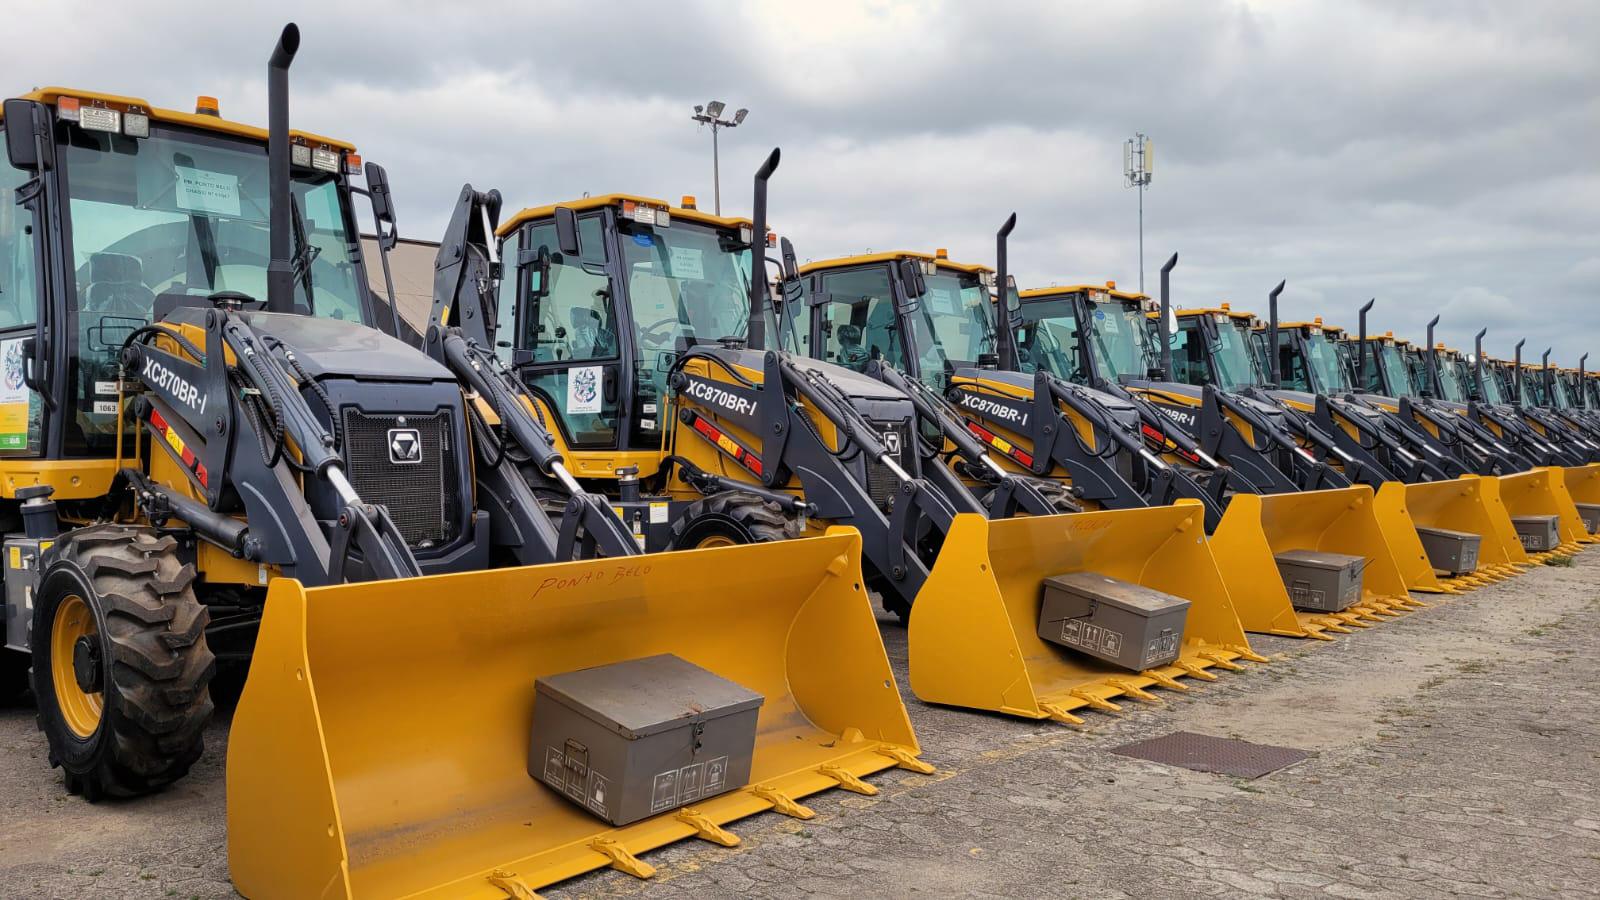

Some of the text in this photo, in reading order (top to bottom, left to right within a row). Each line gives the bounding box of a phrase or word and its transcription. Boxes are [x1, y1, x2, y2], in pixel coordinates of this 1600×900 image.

[142, 355, 207, 415] XC870BR-I
[685, 379, 757, 416] XC870BR-I
[99, 404, 116, 412] 1063
[960, 393, 1028, 426] XC870BR-I
